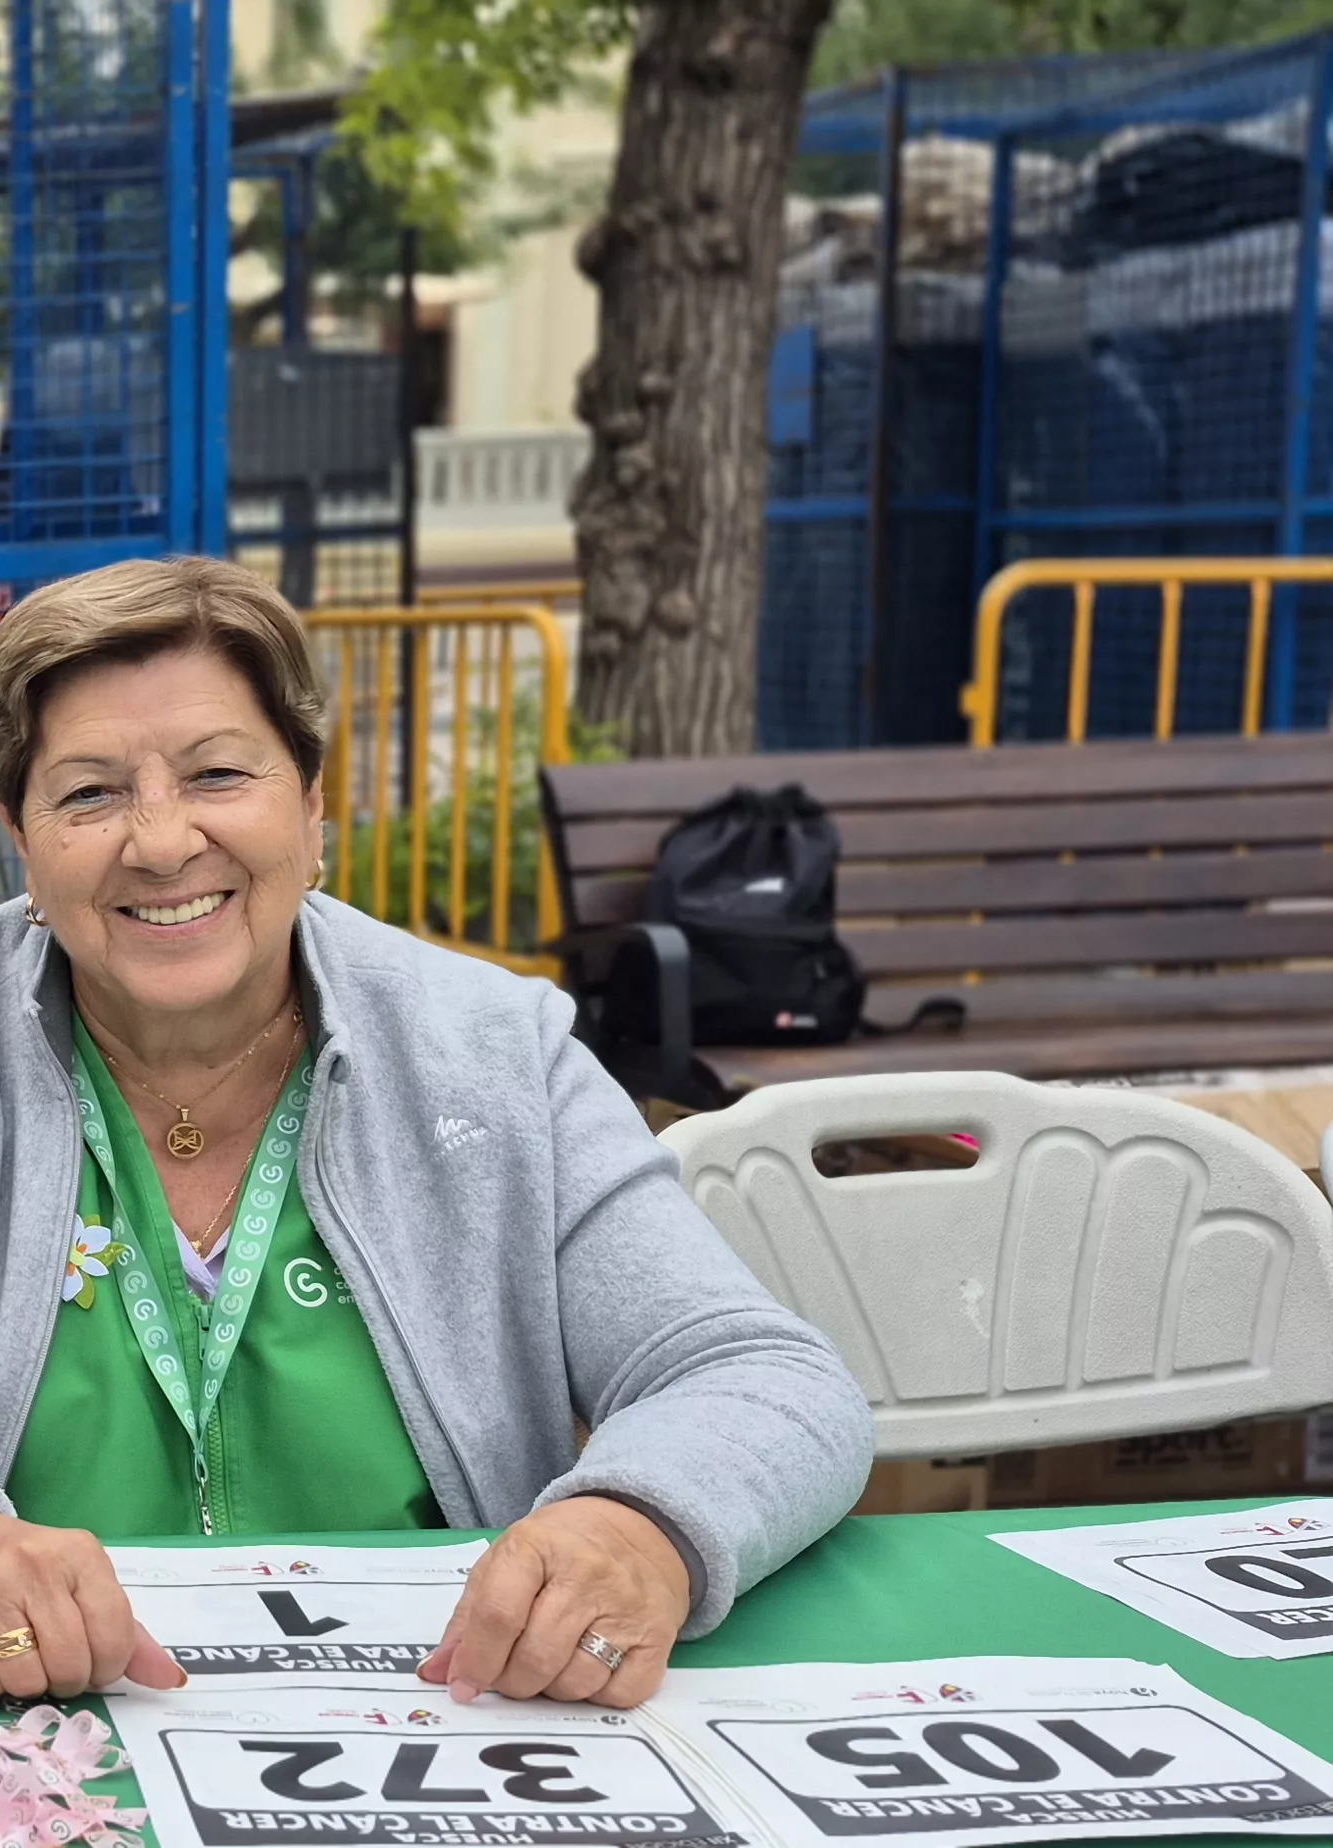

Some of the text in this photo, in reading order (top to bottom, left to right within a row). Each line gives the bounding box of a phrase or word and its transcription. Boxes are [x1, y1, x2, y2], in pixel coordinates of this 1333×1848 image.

[256, 1590, 351, 1637] 1
[1255, 1607, 1333, 1625] CER
[298, 1645, 347, 1659] EL
[273, 1659, 397, 1671] HUESCA
[805, 1718, 1177, 1790] 105
[239, 1739, 610, 1804] 372
[1018, 1793, 1084, 1810] EL
[1081, 1783, 1292, 1807] CONTRA
[817, 1796, 1015, 1817] CÁNCER
[1002, 1808, 1153, 1824] HUESCA
[218, 1812, 688, 1834] CONTRA EL CÁNCER
[391, 1833, 535, 1845] HUESCA
